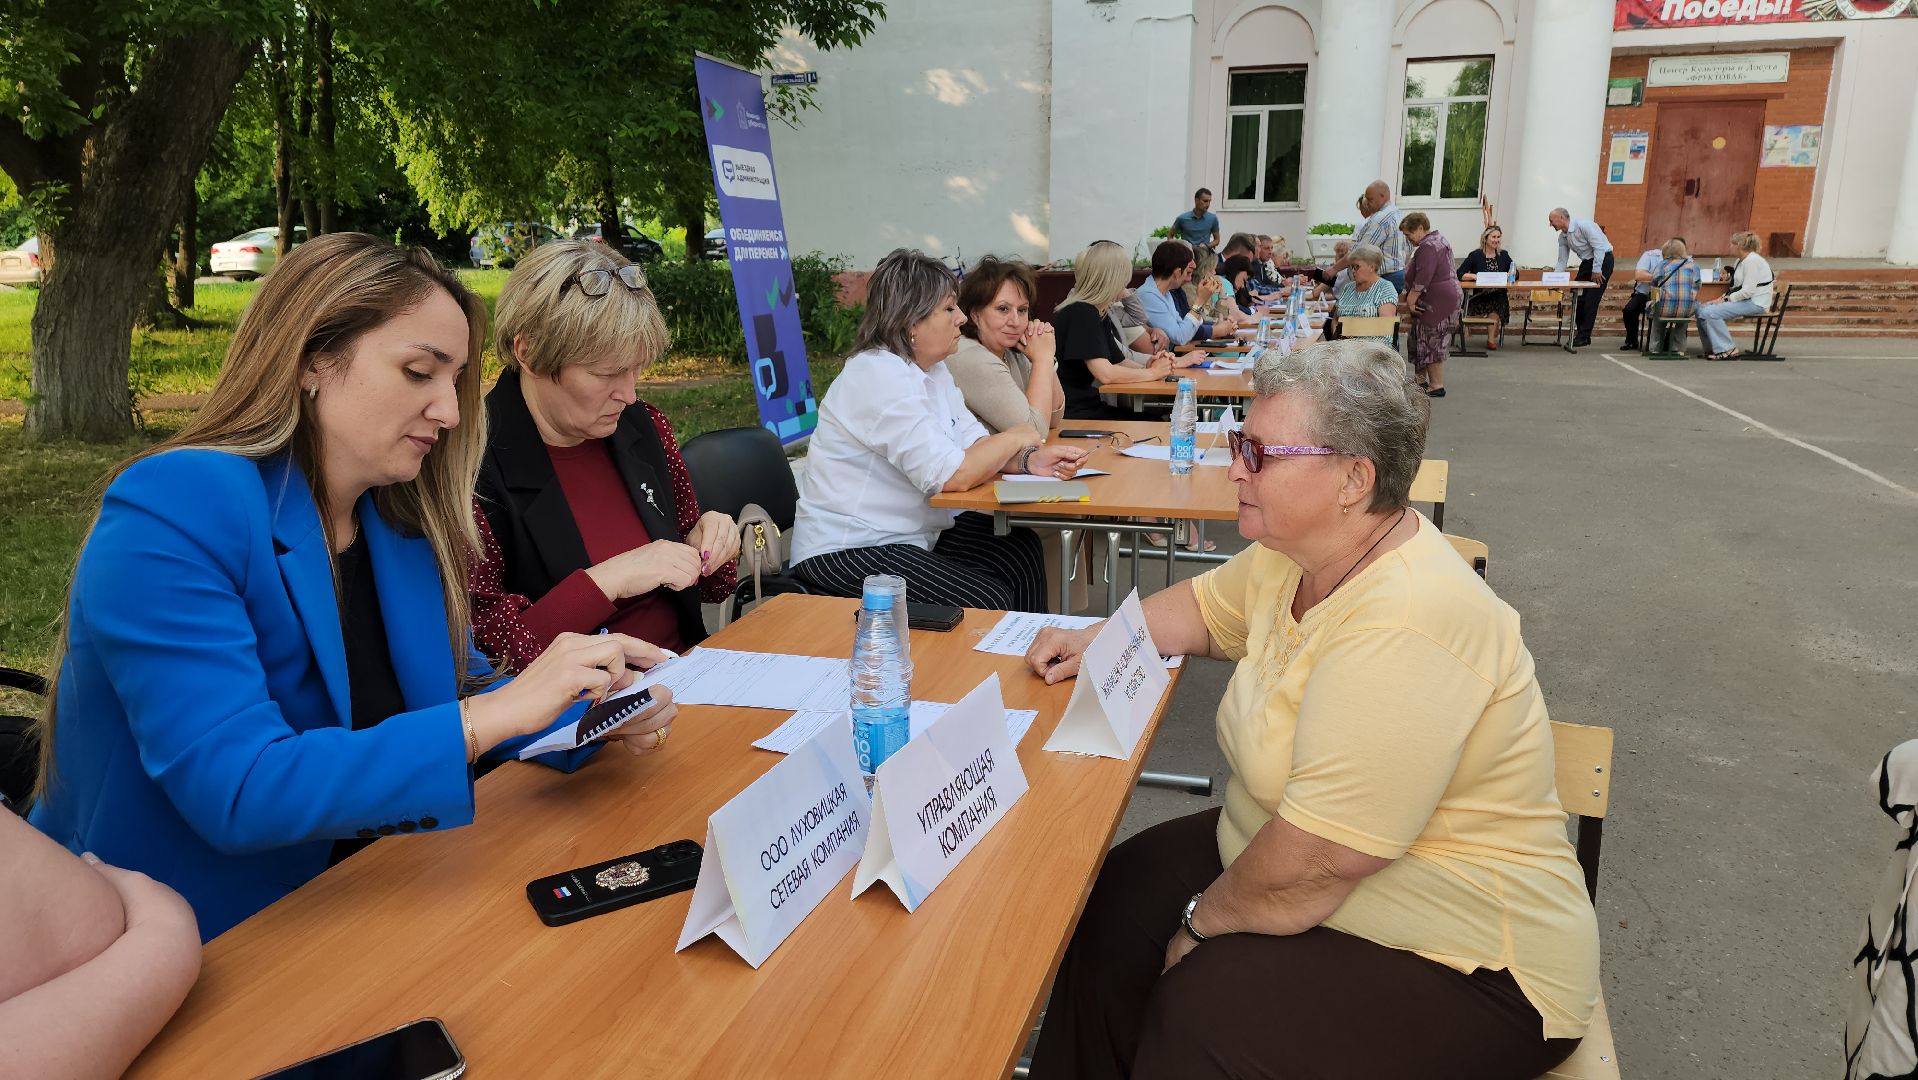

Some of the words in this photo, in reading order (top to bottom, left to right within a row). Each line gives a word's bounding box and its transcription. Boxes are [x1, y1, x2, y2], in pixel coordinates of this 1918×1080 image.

[1660, 0, 1793, 21] Победы!
[730, 228, 784, 243] ОБЪЕДИНЯЕМСЯ
[760, 835, 789, 871] ООО
[790, 782, 848, 847] ЛУХОВИЦКАЯ
[916, 747, 996, 835] УПРАВЛЯЮЩАЯ
[937, 785, 998, 859] КОМПАНИЯ
[770, 858, 812, 910] СЕТЕВАЯ
[810, 810, 861, 869] КОМПАНИЯ
